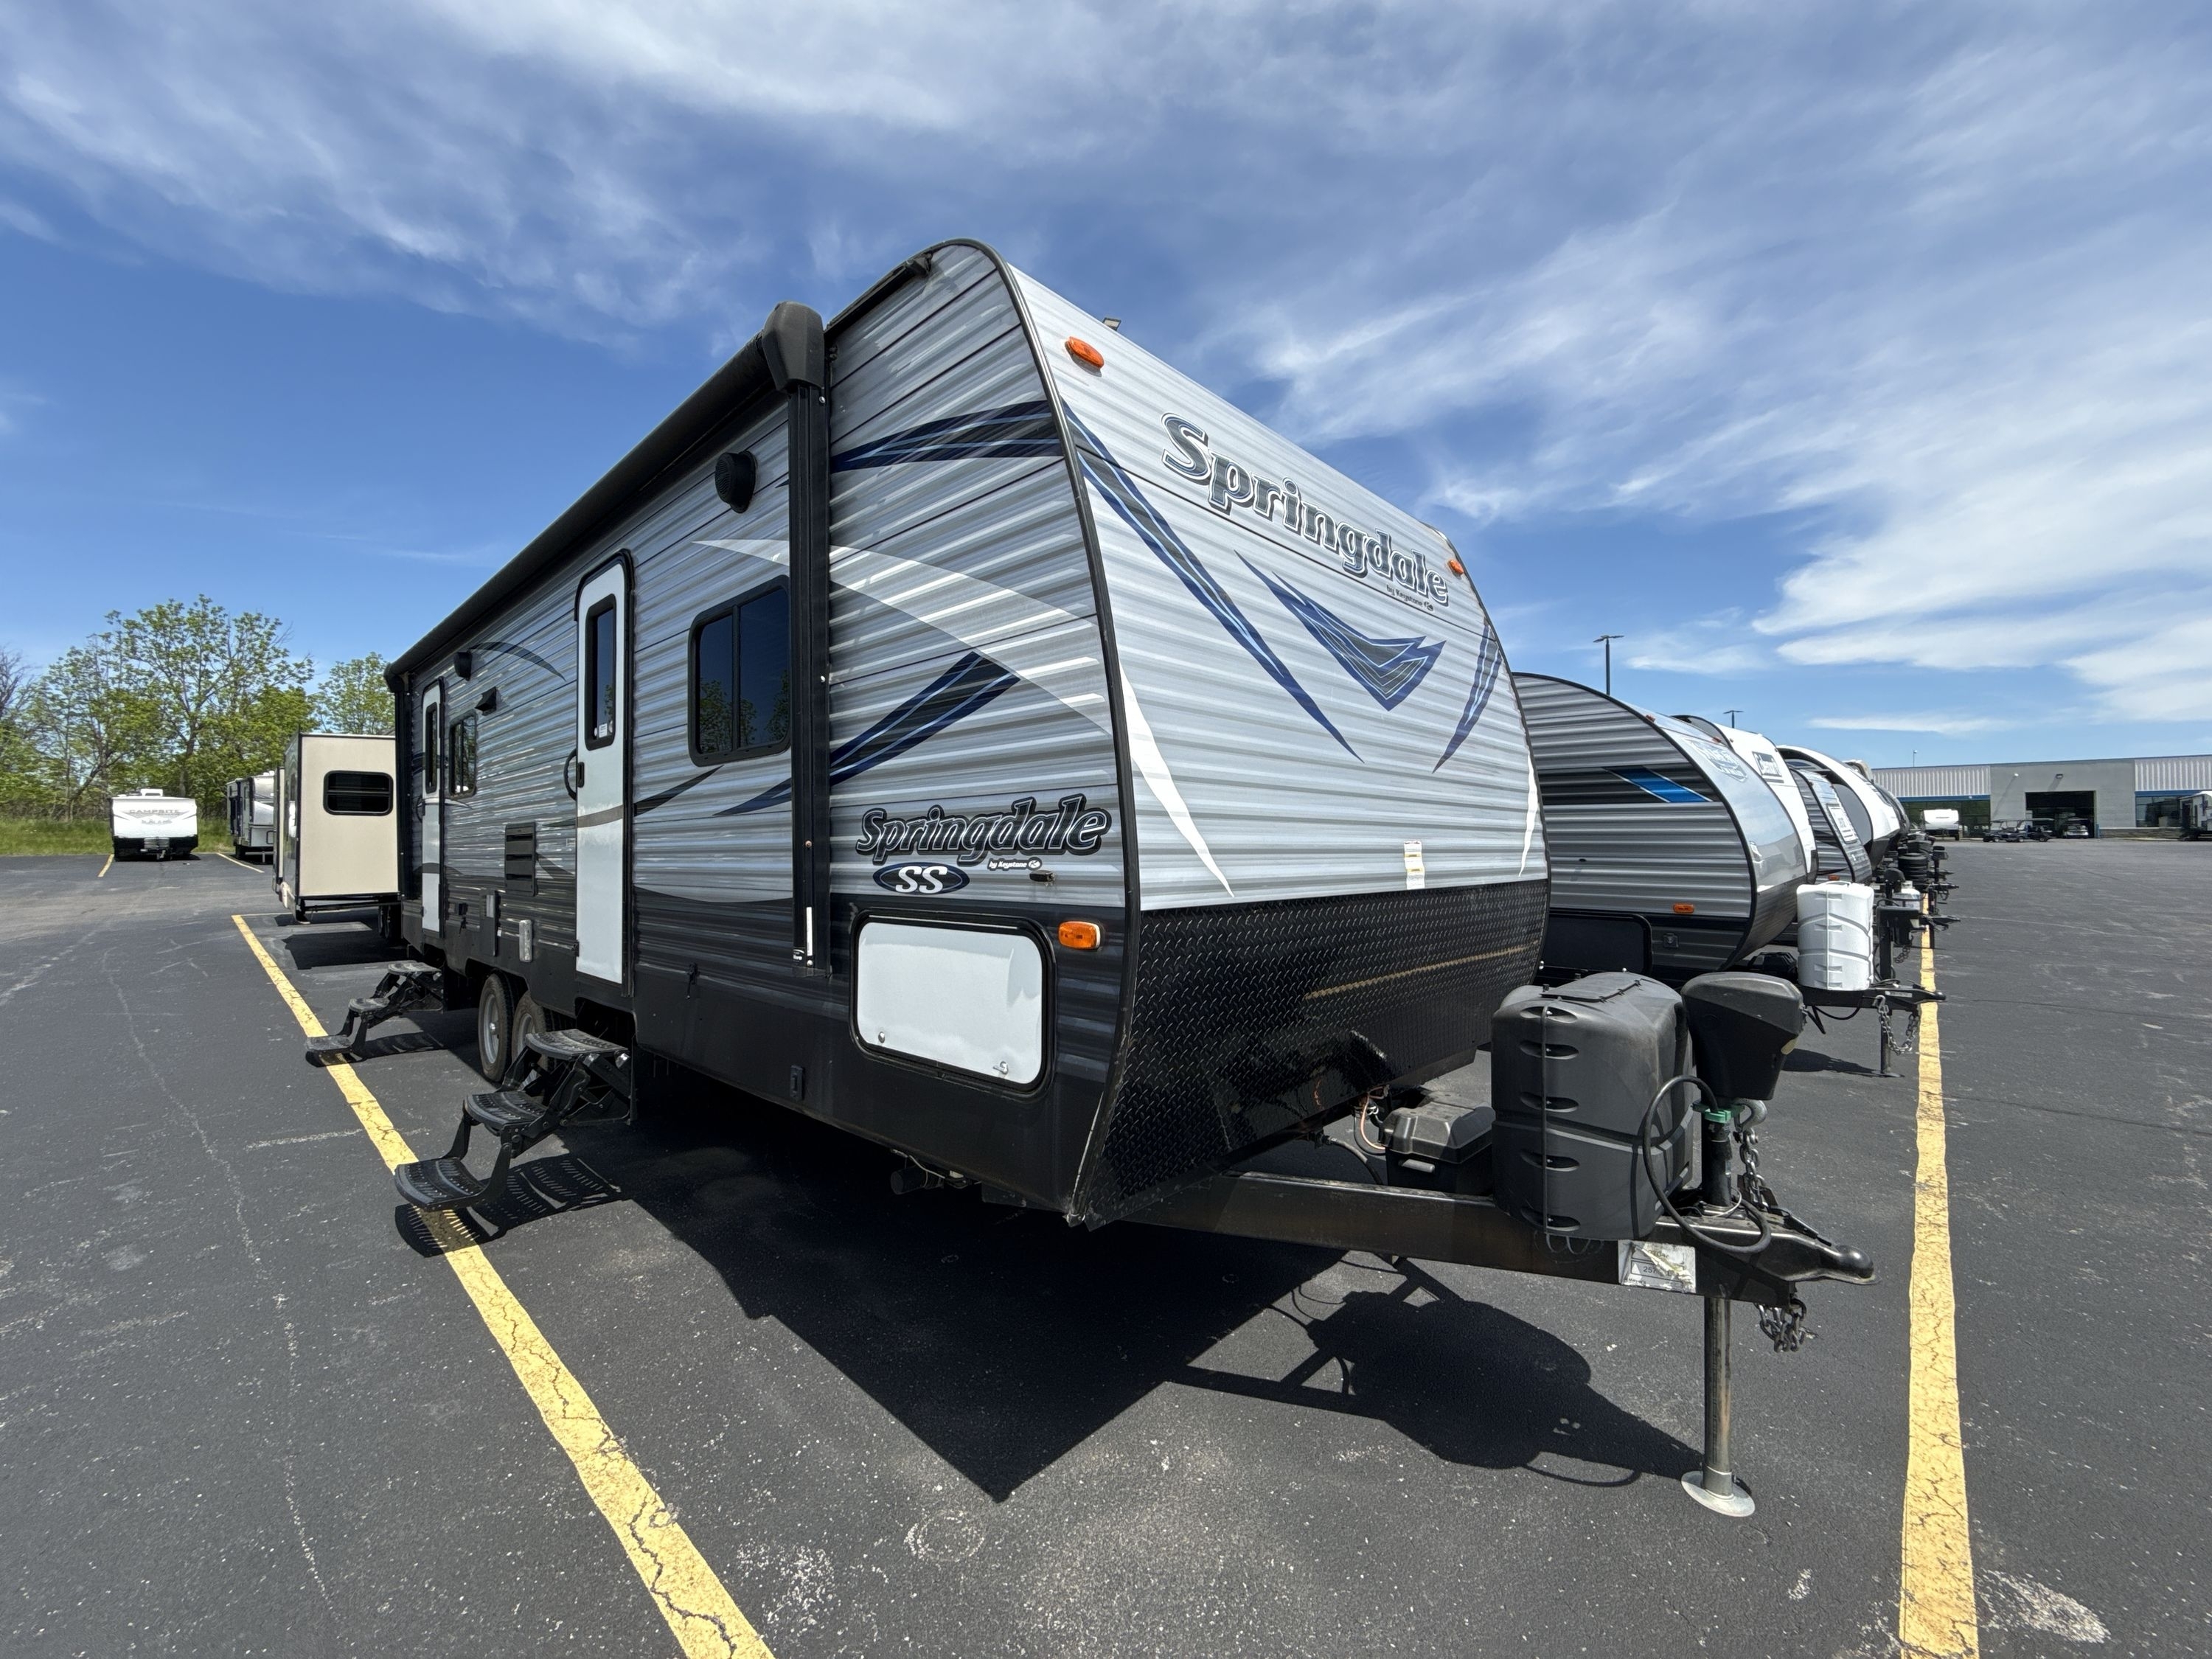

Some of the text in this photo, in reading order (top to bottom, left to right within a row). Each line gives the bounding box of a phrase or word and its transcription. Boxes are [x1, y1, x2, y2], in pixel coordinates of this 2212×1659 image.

[1161, 412, 1449, 606] Springdale
[856, 793, 1112, 866] Springdale
[895, 866, 948, 894] SS
[989, 860, 998, 869] by
[998, 860, 1027, 869] Keystone
